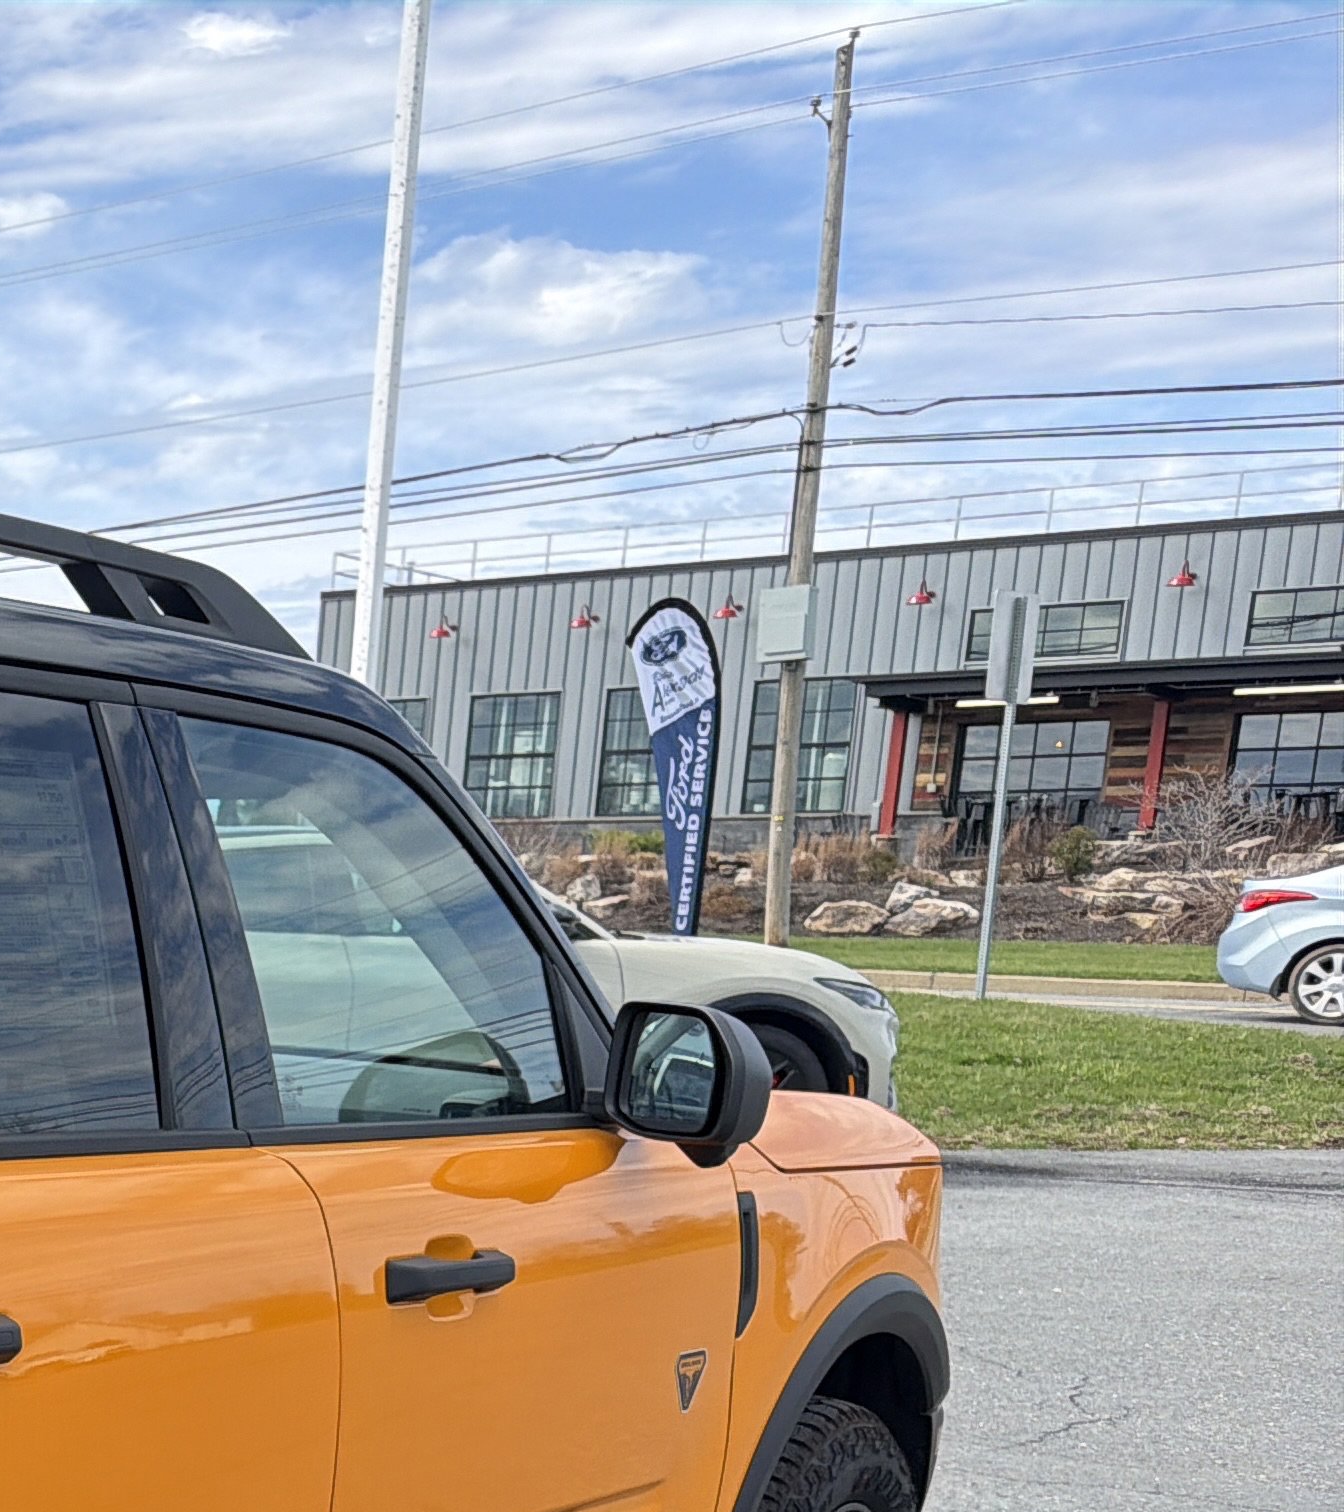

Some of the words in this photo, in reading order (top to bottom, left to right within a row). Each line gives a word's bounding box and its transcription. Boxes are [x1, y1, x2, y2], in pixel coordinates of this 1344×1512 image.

[666, 734, 694, 831] Ford
[675, 813, 701, 932] CERTIFIED
[689, 707, 714, 807] SERVICE
